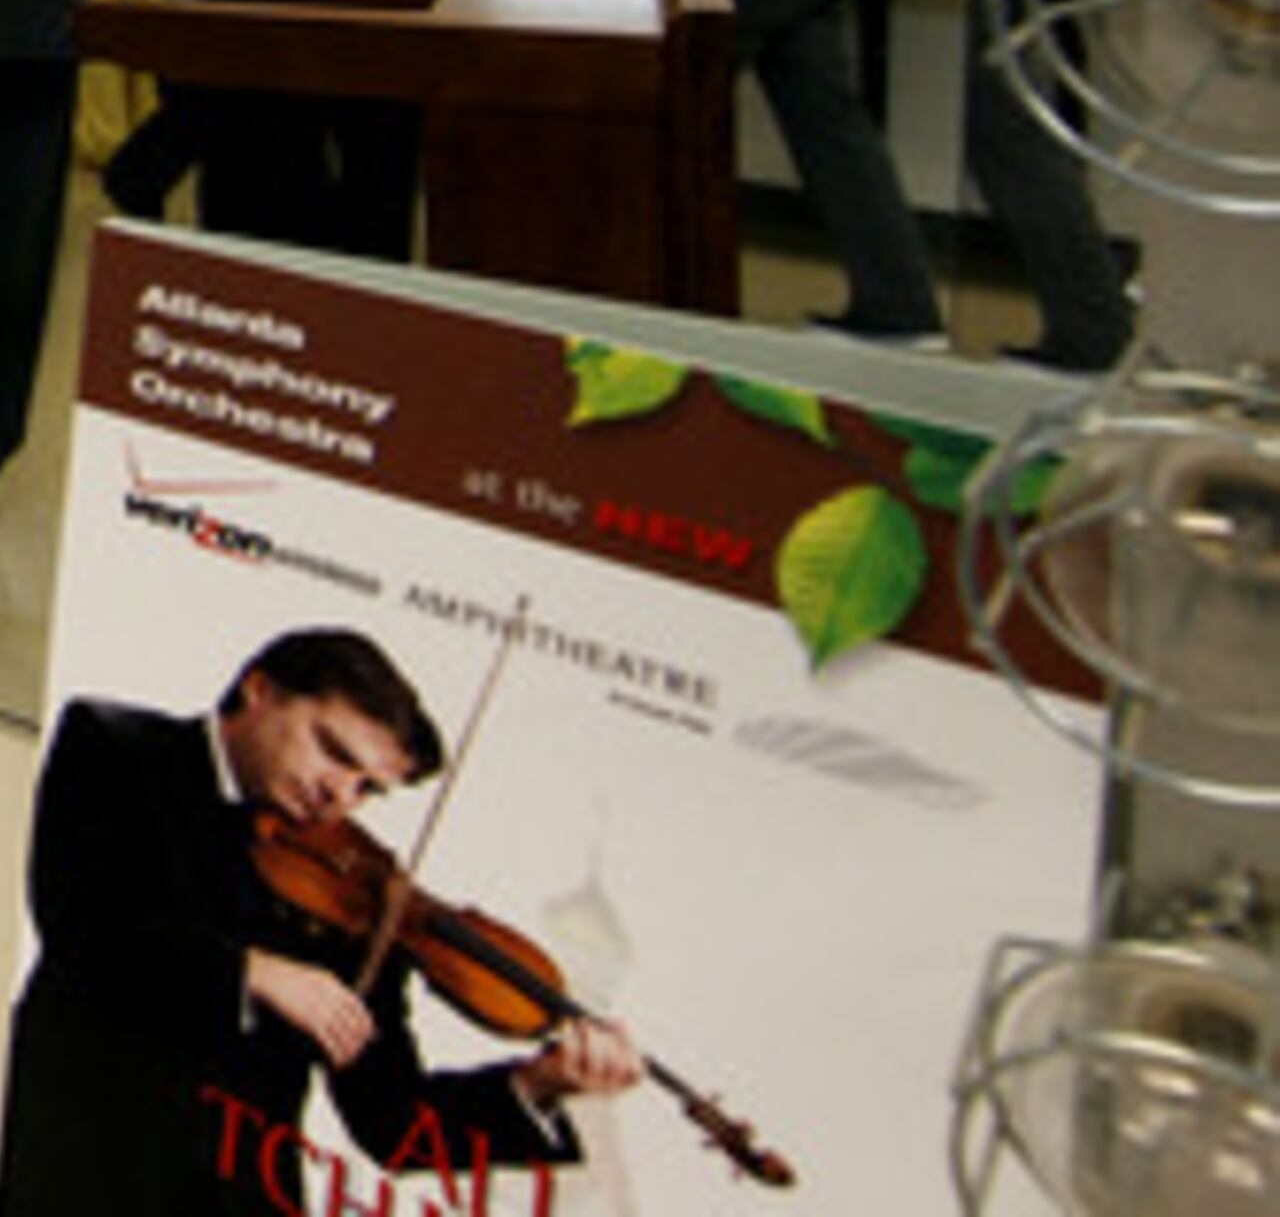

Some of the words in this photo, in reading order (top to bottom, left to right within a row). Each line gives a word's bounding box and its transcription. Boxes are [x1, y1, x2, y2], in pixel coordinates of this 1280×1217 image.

[138, 284, 306, 351] Atlanta
[130, 370, 376, 463] Orchestra
[134, 324, 395, 425] Symphony
[462, 469, 503, 502] at
[516, 478, 582, 527] the
[595, 500, 754, 569] NEW
